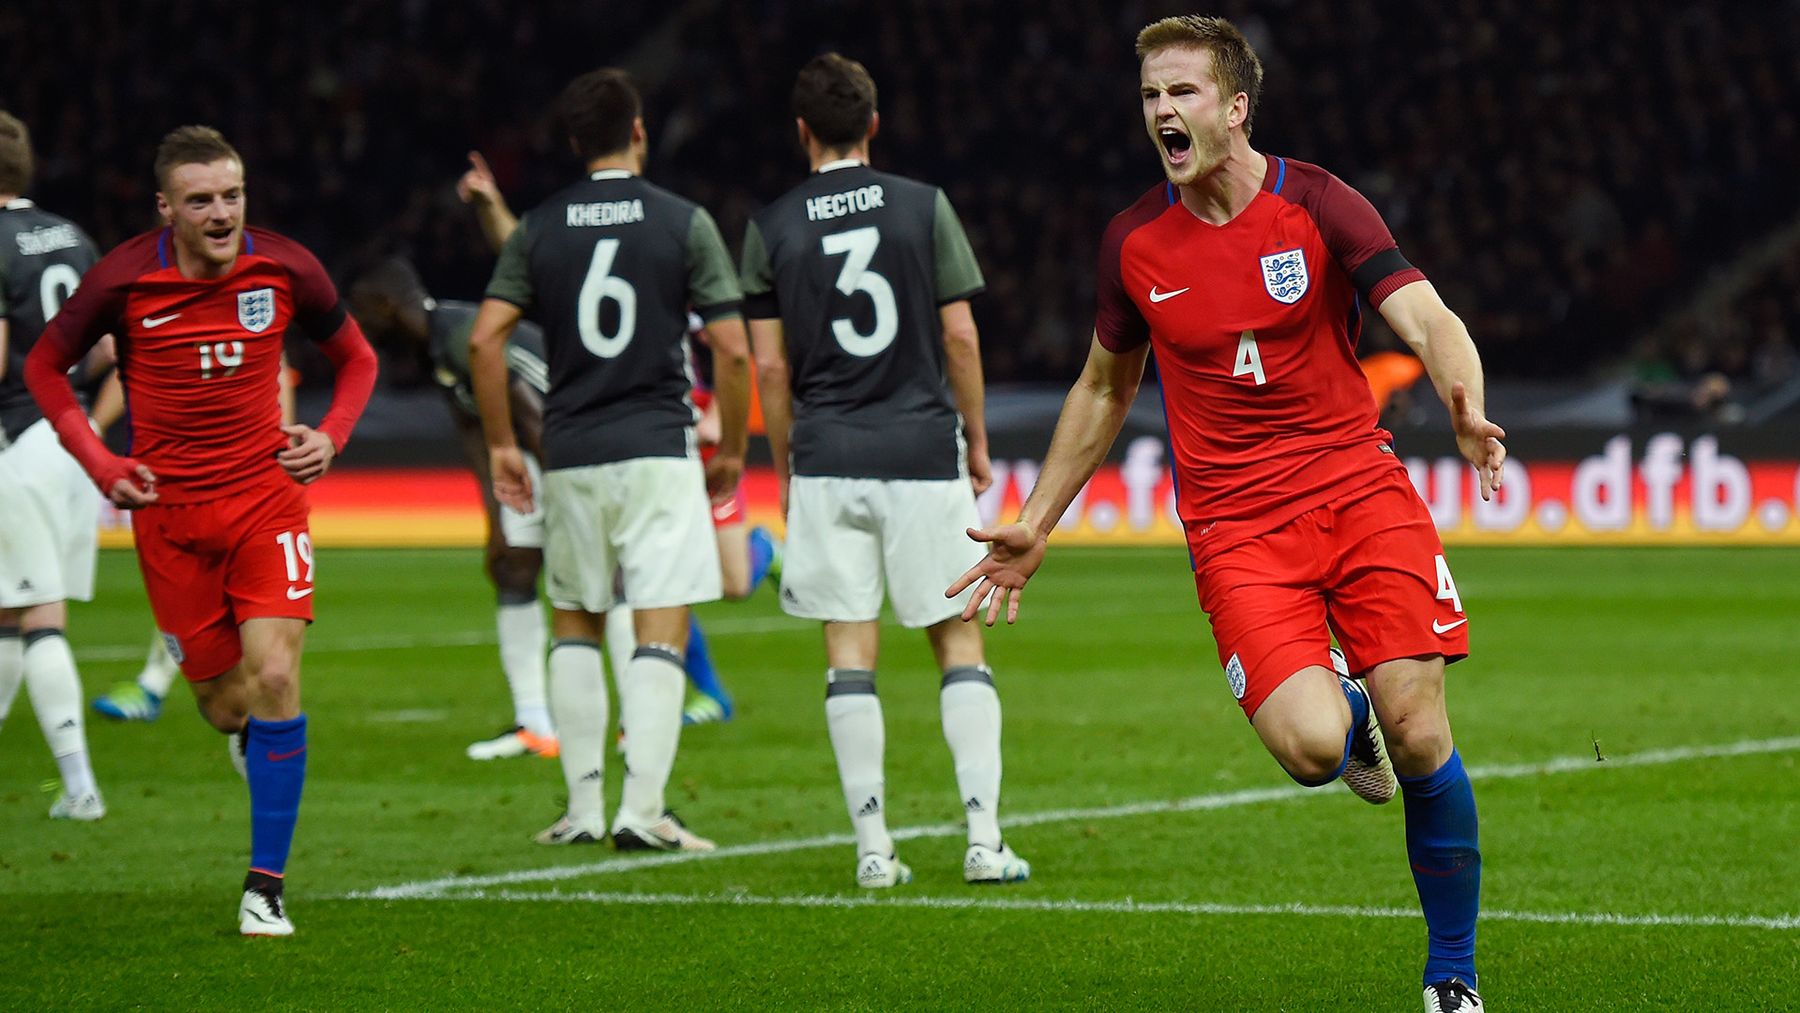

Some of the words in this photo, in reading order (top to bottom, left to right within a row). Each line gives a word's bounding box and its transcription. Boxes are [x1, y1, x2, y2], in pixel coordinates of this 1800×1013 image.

[566, 199, 645, 228] KHEDIRA
[806, 185, 885, 221] HECTOR
[577, 238, 637, 359] 6
[821, 226, 899, 358] 3
[198, 341, 244, 379] 19
[1232, 329, 1267, 386] 4
[276, 531, 314, 582] 19
[1435, 554, 1463, 613] 4
